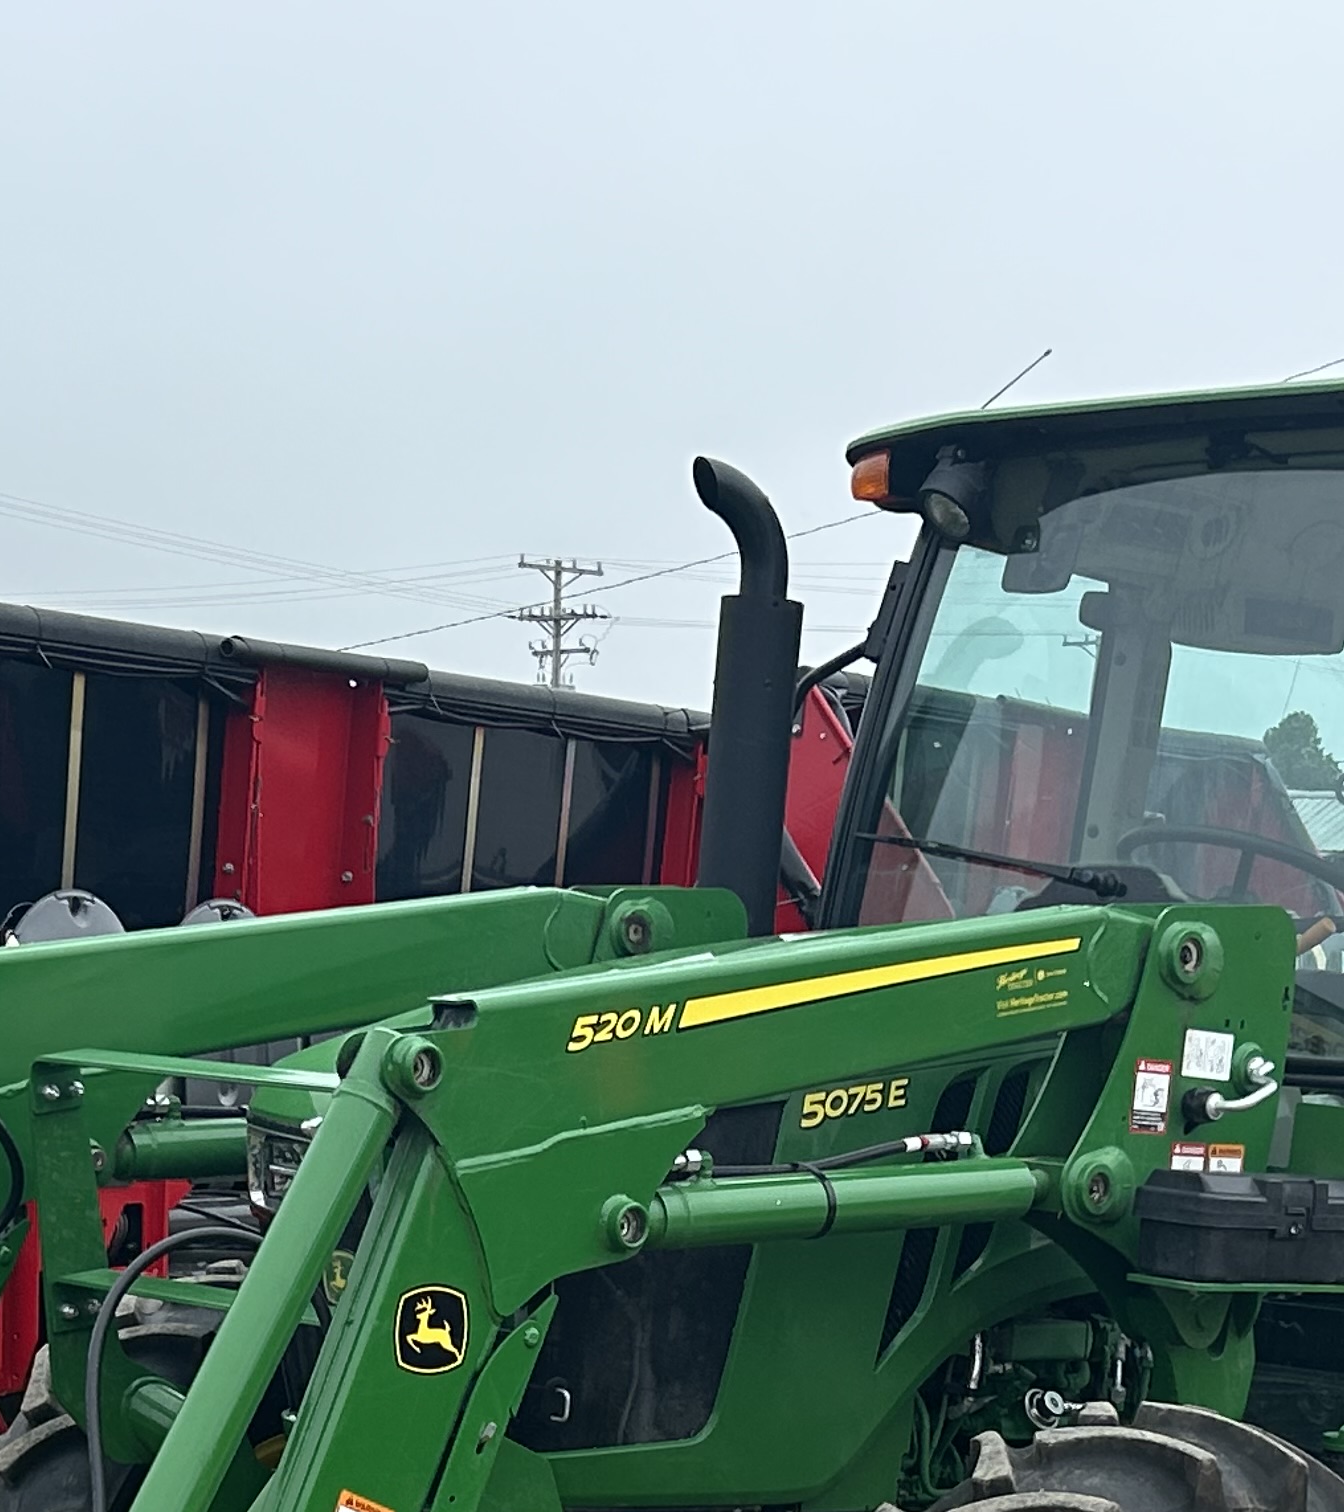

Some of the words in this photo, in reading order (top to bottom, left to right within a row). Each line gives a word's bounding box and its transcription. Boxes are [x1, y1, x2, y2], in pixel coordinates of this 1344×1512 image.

[566, 1009, 642, 1053] 520
[643, 1003, 677, 1036] M
[800, 1082, 884, 1128] 5075
[887, 1078, 909, 1108] E
